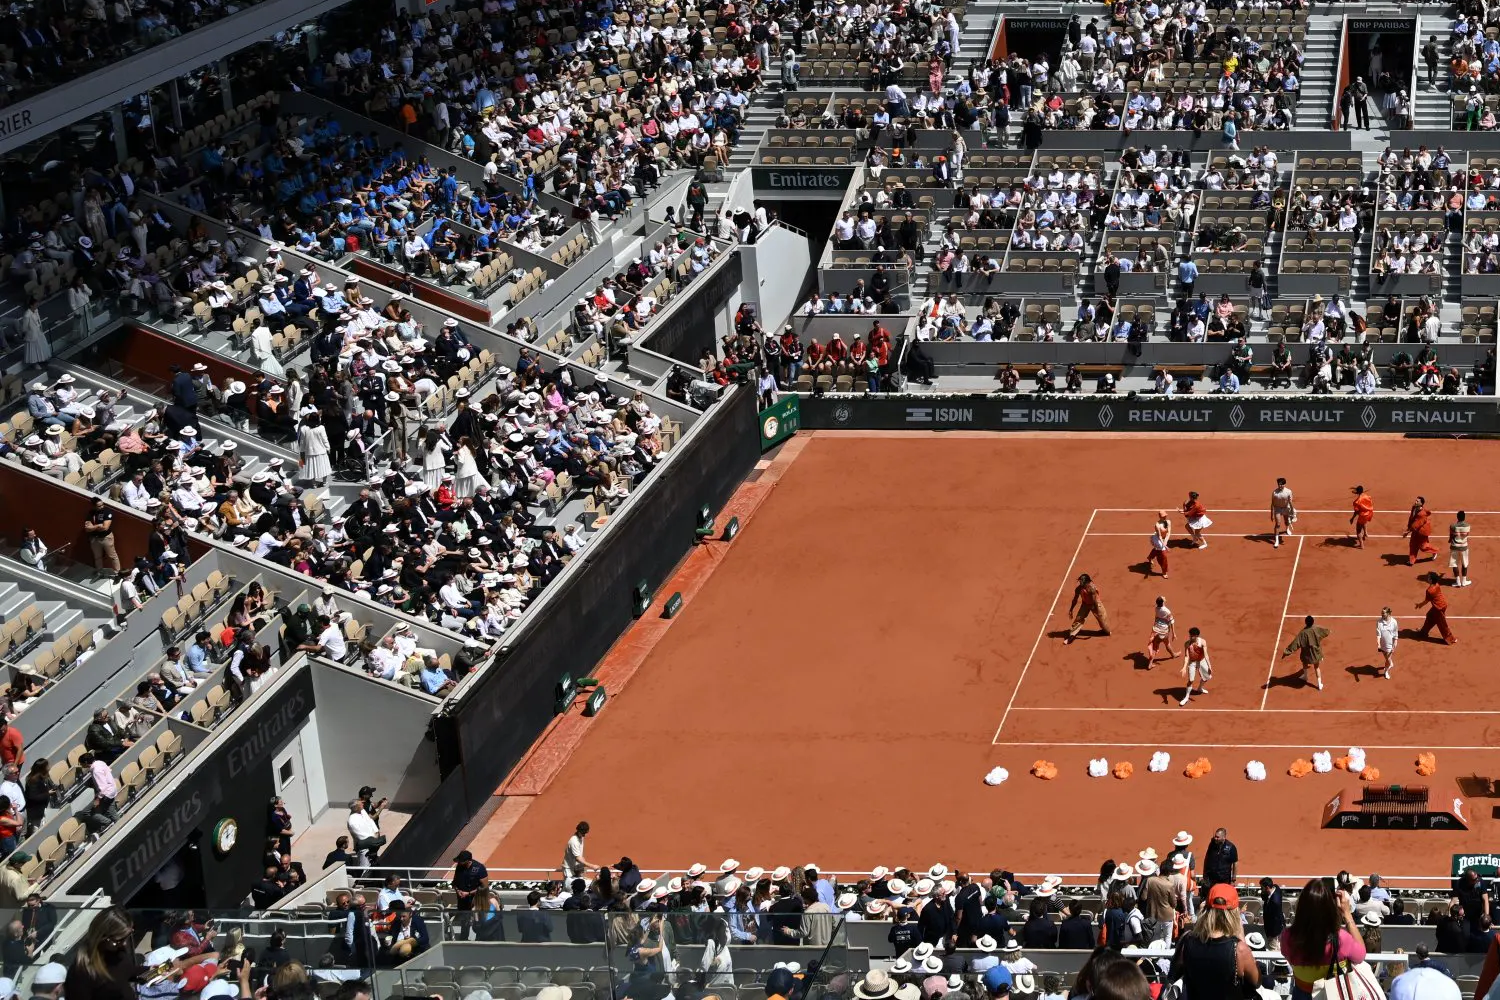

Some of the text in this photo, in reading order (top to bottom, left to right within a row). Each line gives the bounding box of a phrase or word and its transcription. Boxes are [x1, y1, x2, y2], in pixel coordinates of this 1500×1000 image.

[1010, 21, 1067, 29] BNP PARIBAS
[1353, 21, 1410, 29] BNP PARIBAS
[768, 172, 840, 187] Emirates
[936, 408, 973, 422] ISDIN
[1031, 409, 1069, 423] ISDIN
[1128, 410, 1212, 421] RENAULT
[1260, 410, 1344, 422] RENAULT
[1391, 410, 1476, 423] RENAULT
[110, 791, 203, 890] Emirates
